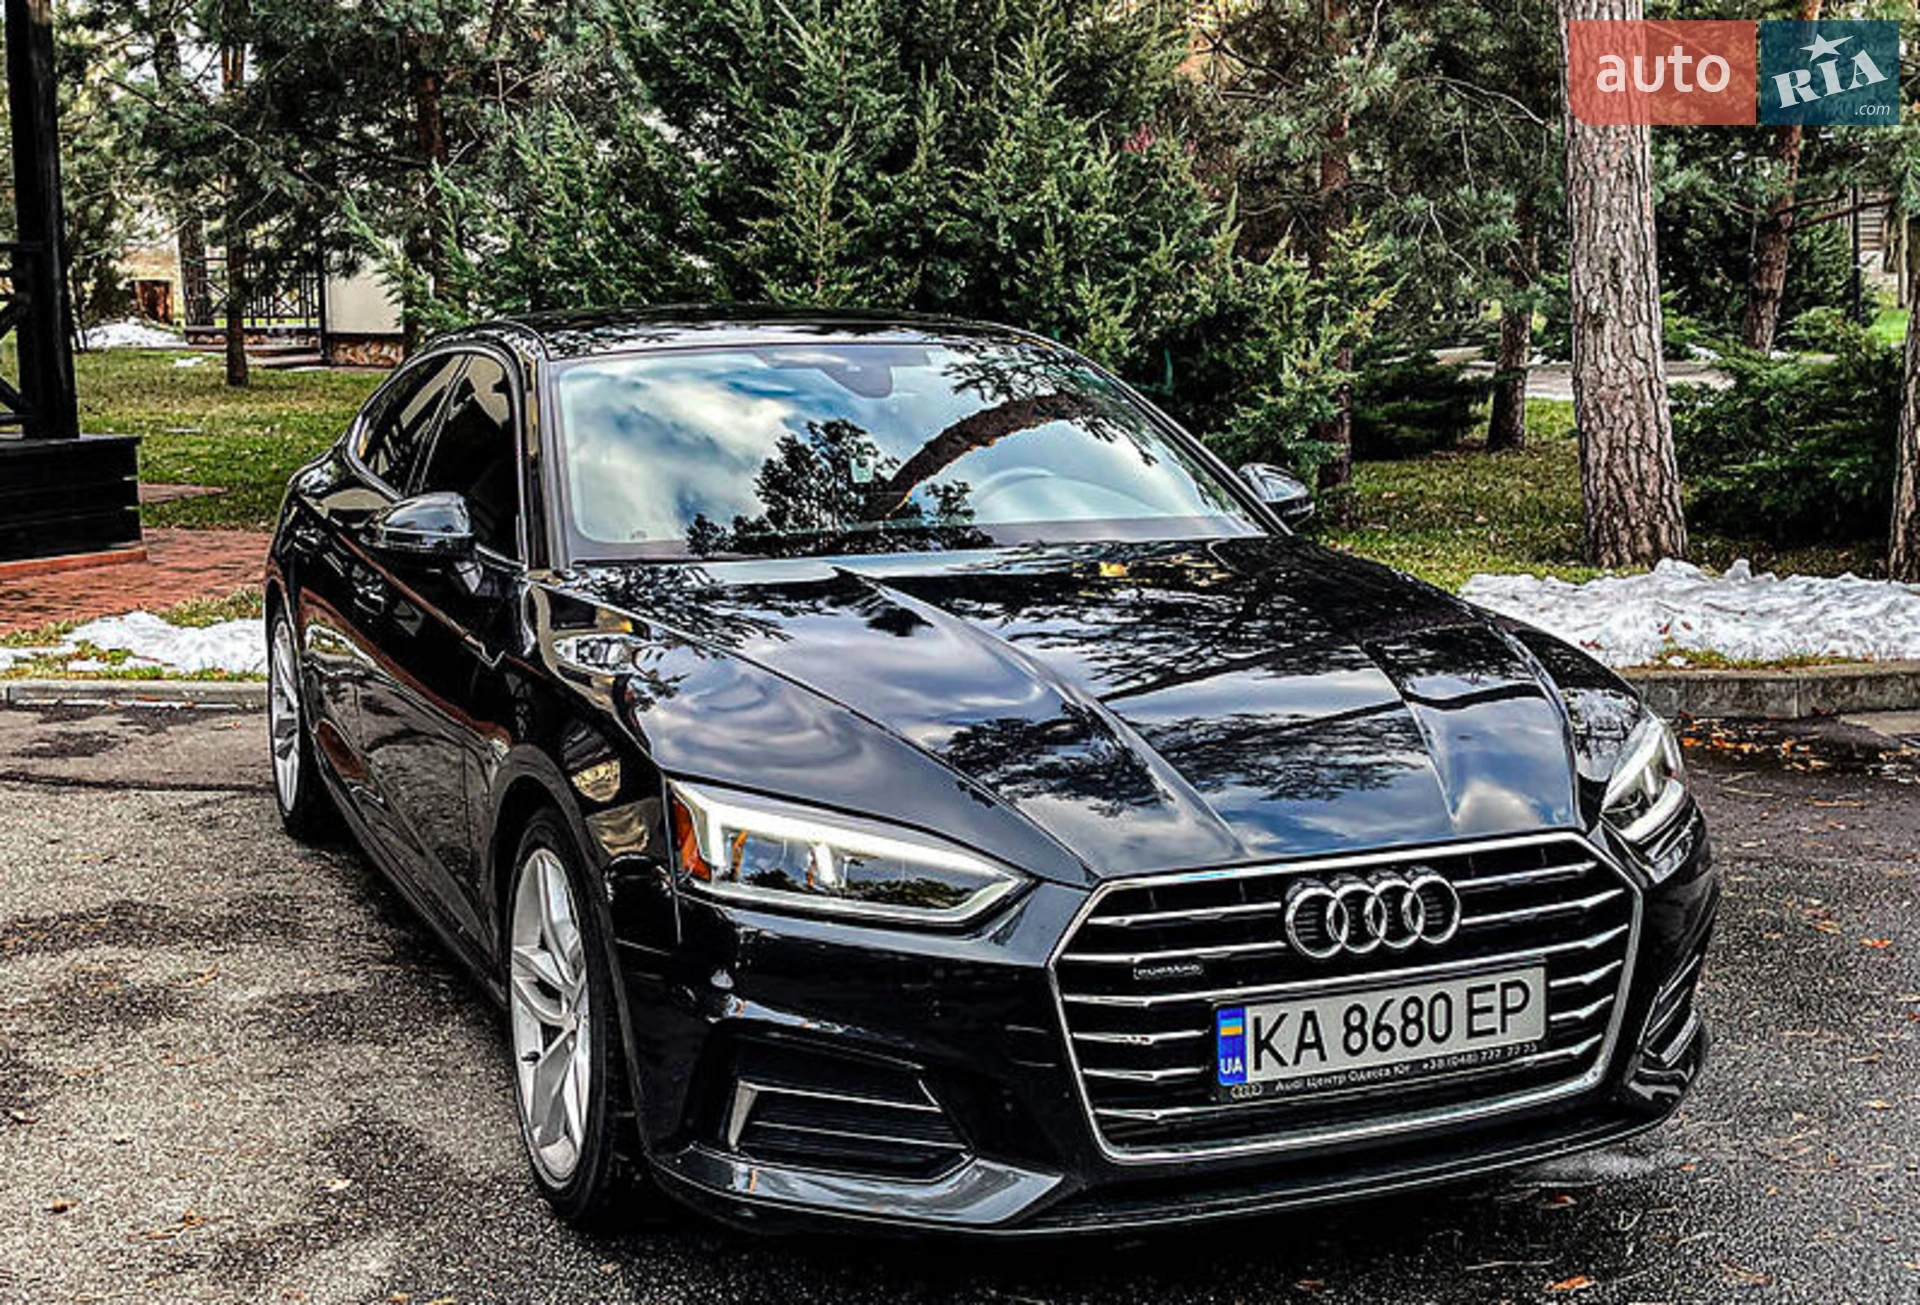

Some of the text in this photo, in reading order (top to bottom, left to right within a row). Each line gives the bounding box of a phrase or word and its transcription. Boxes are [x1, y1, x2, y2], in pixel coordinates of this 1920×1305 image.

[1252, 979, 1531, 1072] KA 8680 EP
[1219, 1056, 1244, 1075] UA
